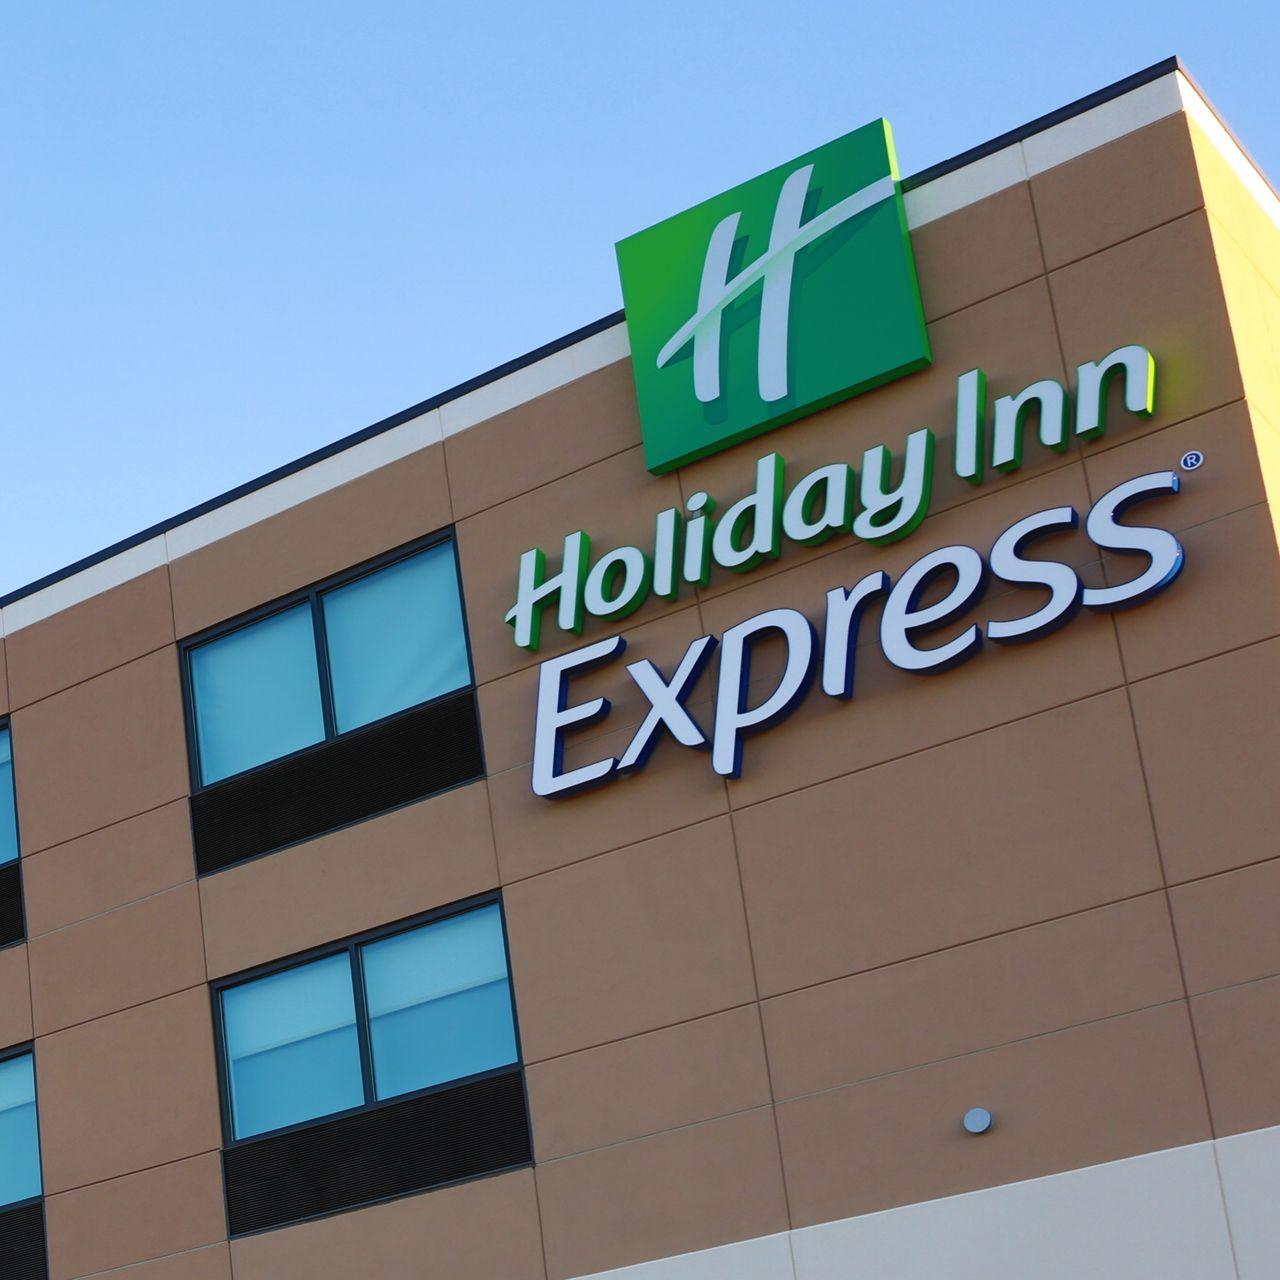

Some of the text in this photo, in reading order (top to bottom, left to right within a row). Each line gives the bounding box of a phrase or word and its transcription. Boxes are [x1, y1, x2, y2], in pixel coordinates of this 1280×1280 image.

[505, 344, 1156, 650] Holiday Inn
[531, 470, 1184, 798] Express
